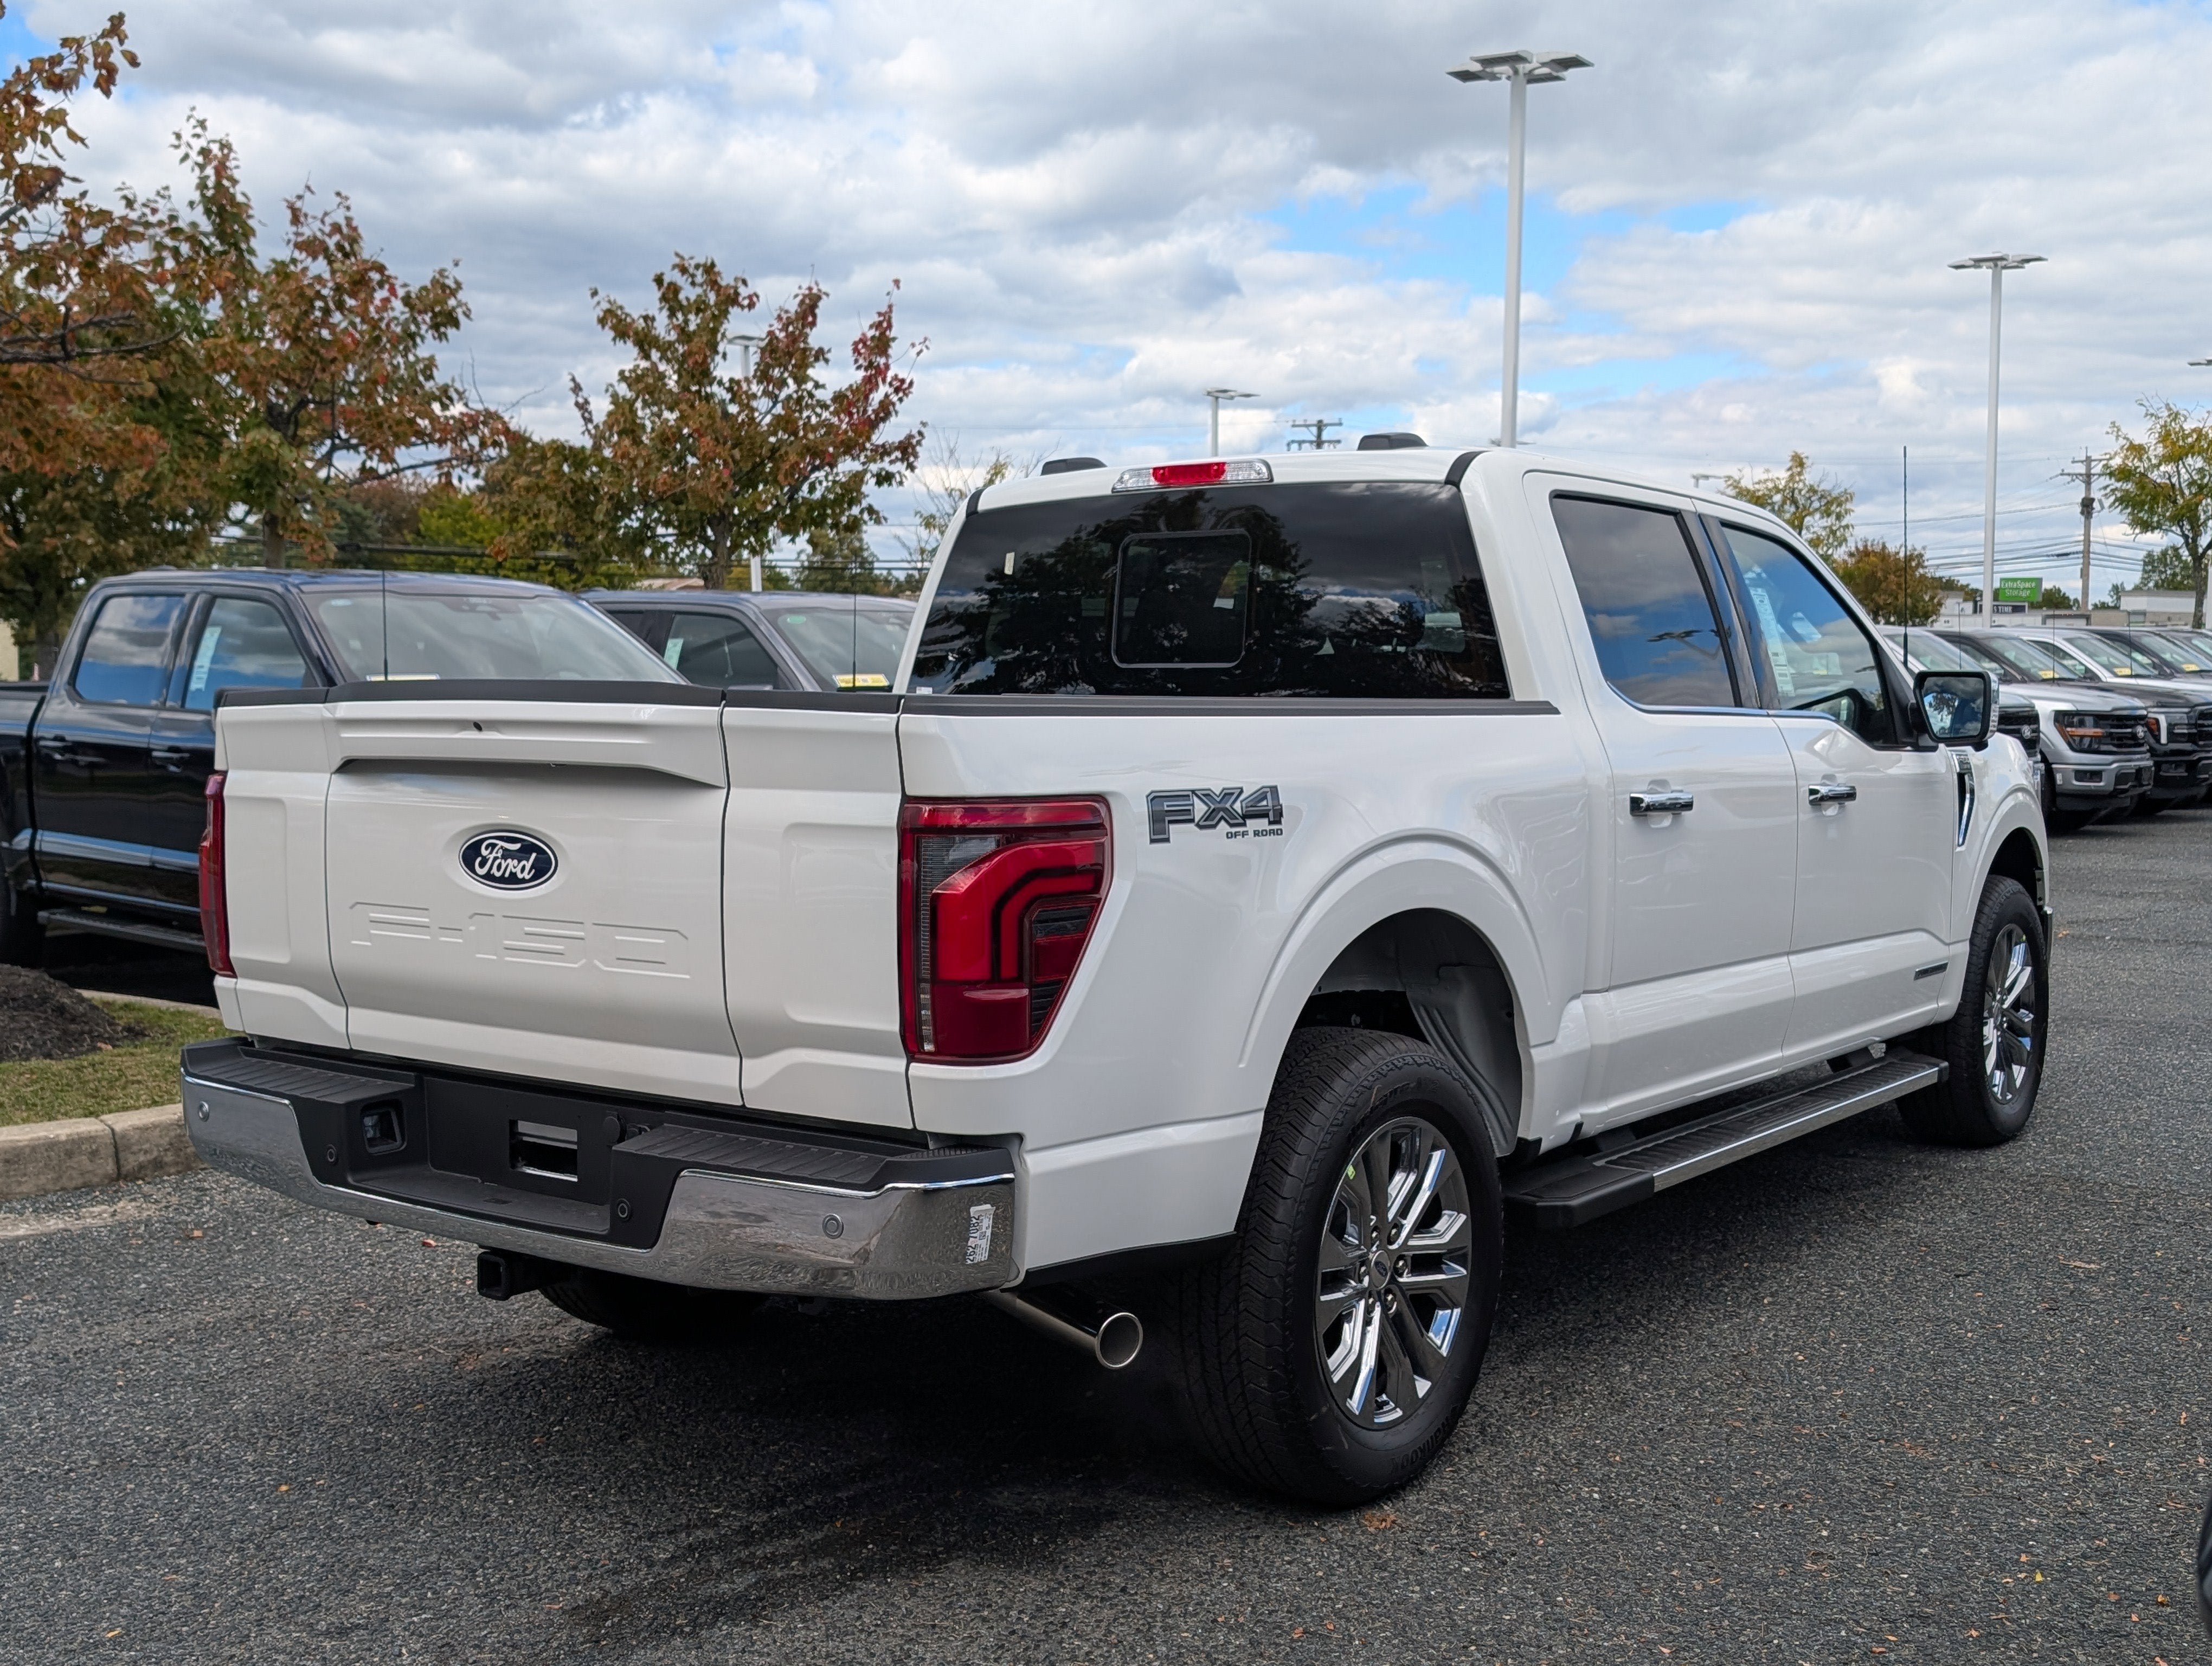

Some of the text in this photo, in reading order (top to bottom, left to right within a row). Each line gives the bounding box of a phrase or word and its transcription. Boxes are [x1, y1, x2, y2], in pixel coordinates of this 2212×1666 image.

[2005, 589, 2030, 598] Storage
[1146, 785, 1284, 844] FX4
[1226, 828, 1283, 839] OFF ROAD
[474, 839, 536, 880] Ford
[349, 902, 690, 978] F-150
